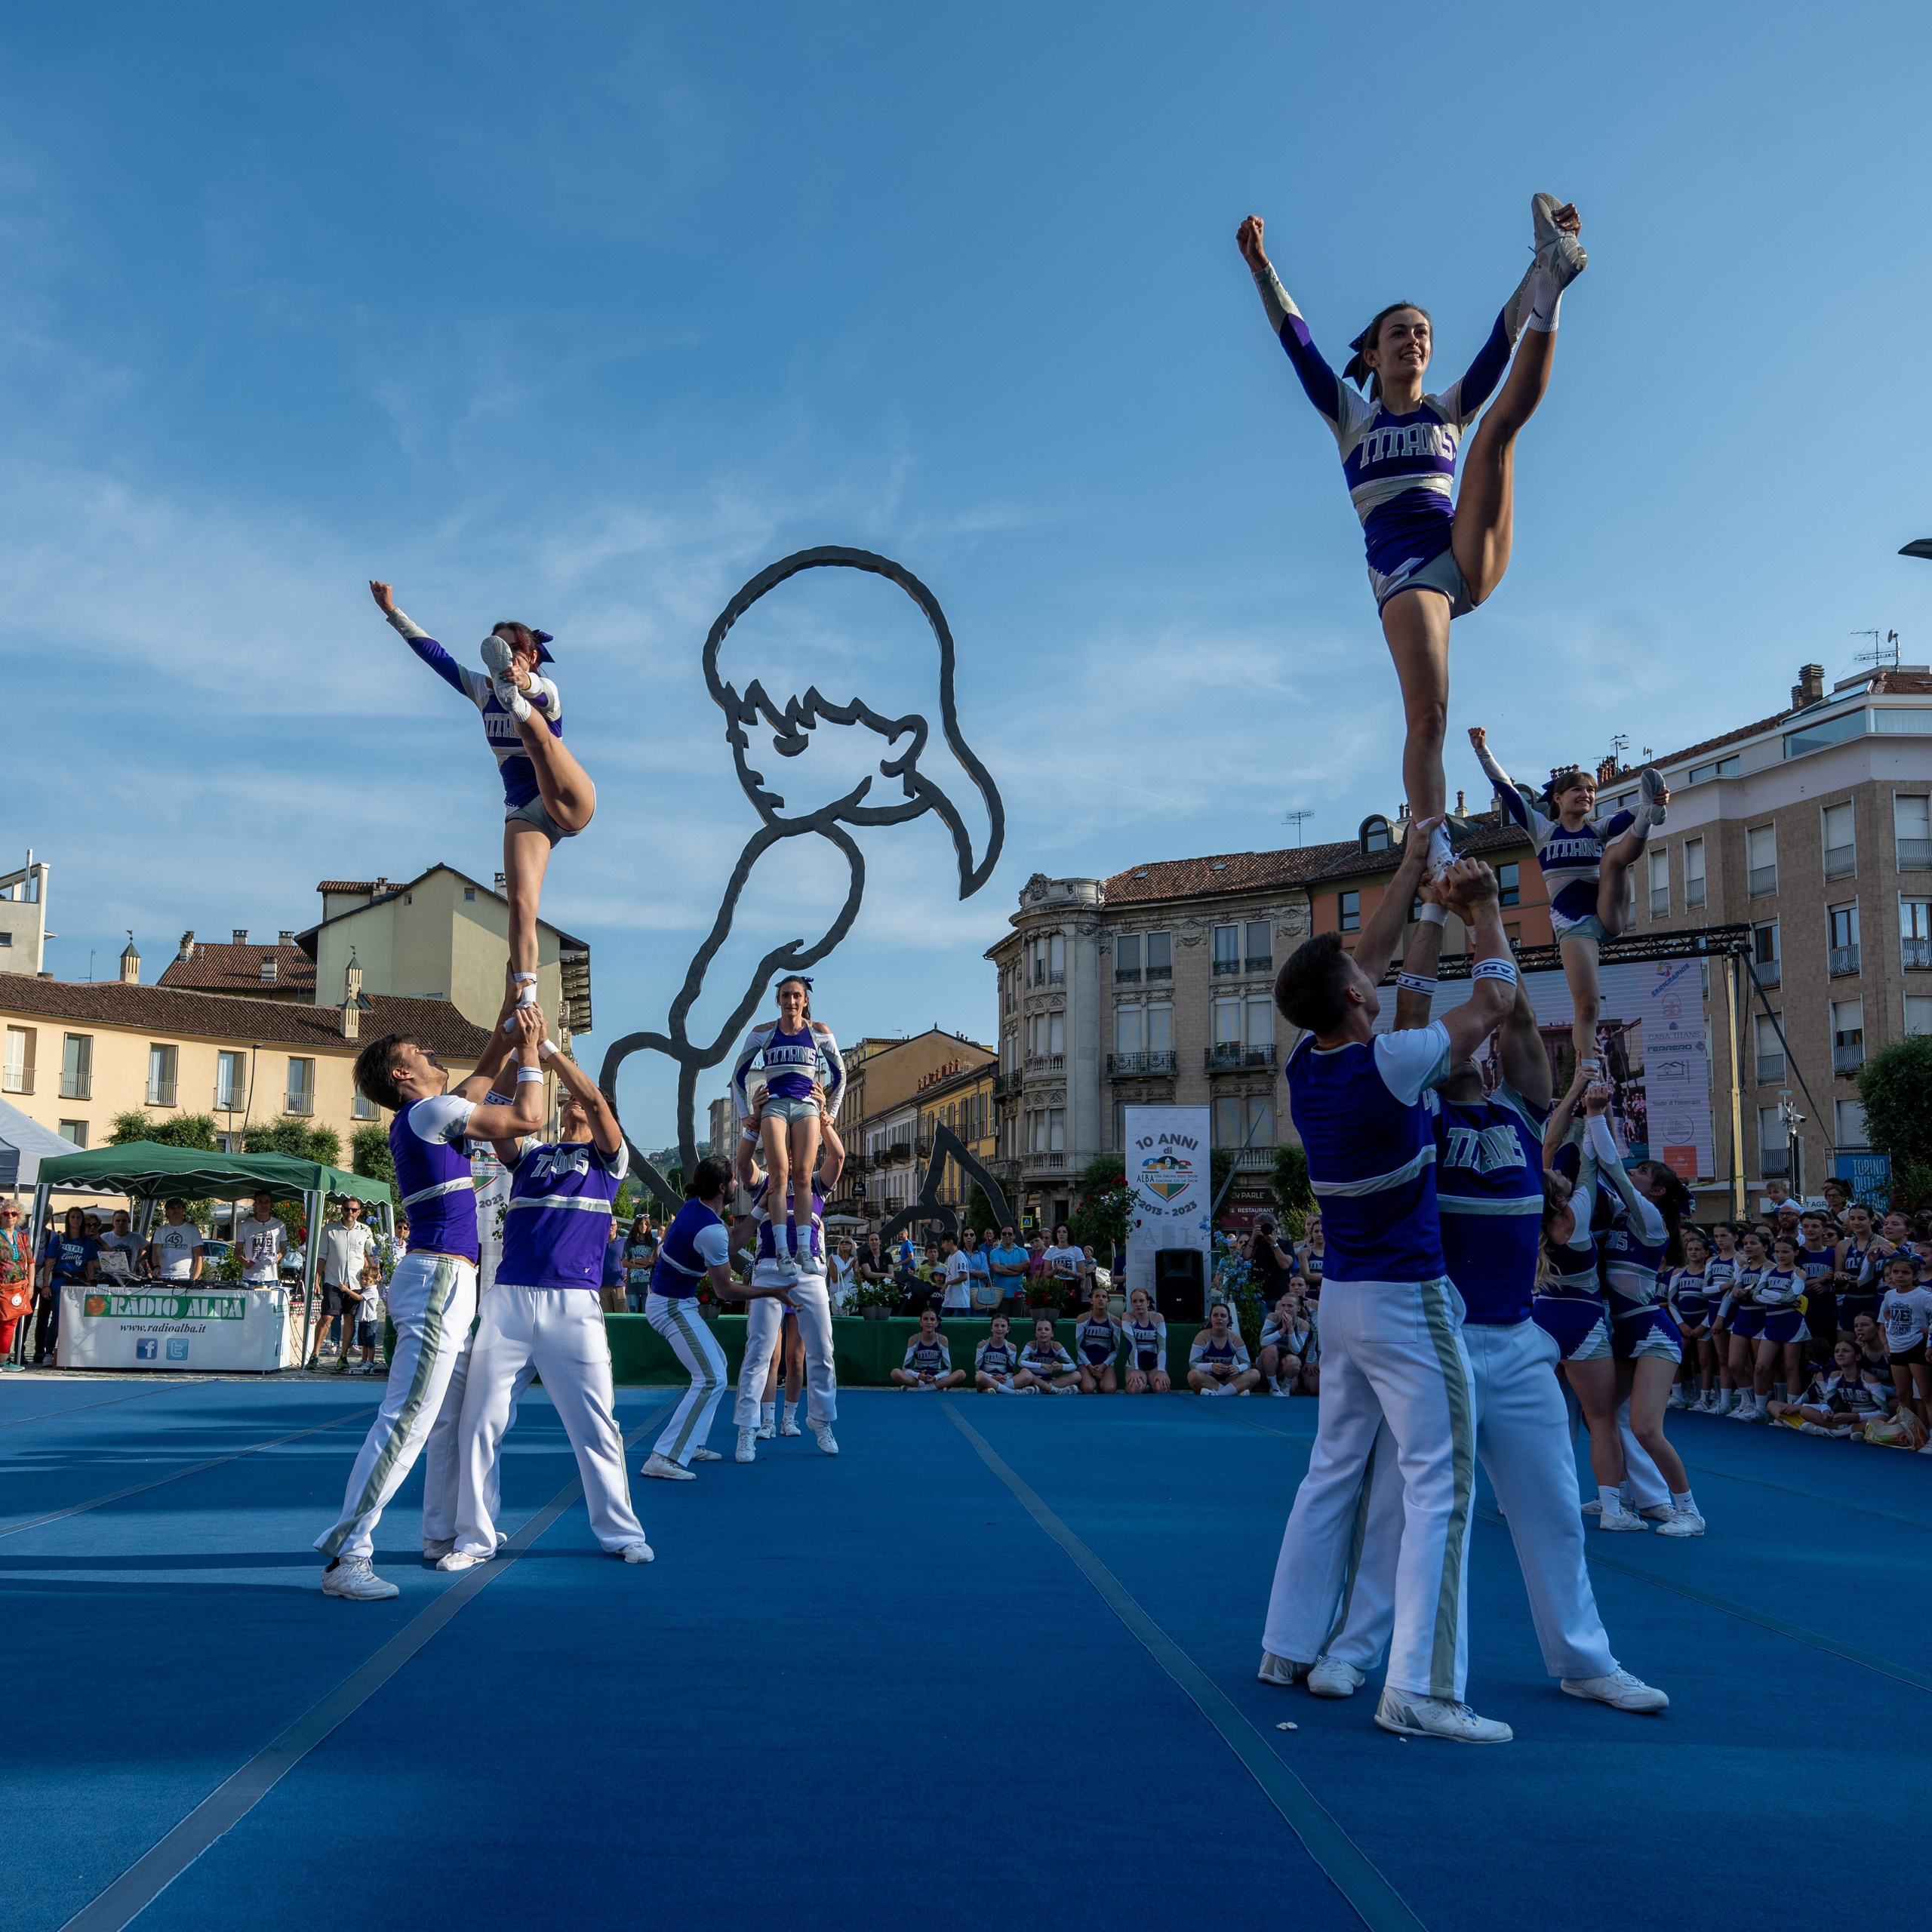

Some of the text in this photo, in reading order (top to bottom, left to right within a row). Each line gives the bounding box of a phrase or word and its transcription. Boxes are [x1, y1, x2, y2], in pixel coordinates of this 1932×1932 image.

[1359, 423, 1458, 469] TITANS
[485, 712, 521, 738] TITA
[1544, 838, 1604, 861] TITANS
[1651, 963, 1690, 998] SERIGRAPHIS
[1648, 1032, 1670, 1041] CASA
[766, 1045, 816, 1065] TITANS
[1135, 1133, 1199, 1151] 10 ANNI
[1163, 1146, 1172, 1155] di
[530, 1147, 589, 1178] TIANS
[1852, 1159, 1885, 1175] TORINO
[1137, 1174, 1155, 1183] ALBA
[478, 1193, 504, 1208] 2023
[1138, 1200, 1162, 1216] 2013
[1172, 1201, 1198, 1217] 2023
[168, 1235, 180, 1244] 45
[110, 1297, 243, 1318] RADIO ALBA
[120, 1323, 206, 1334] www.radioalba.it
